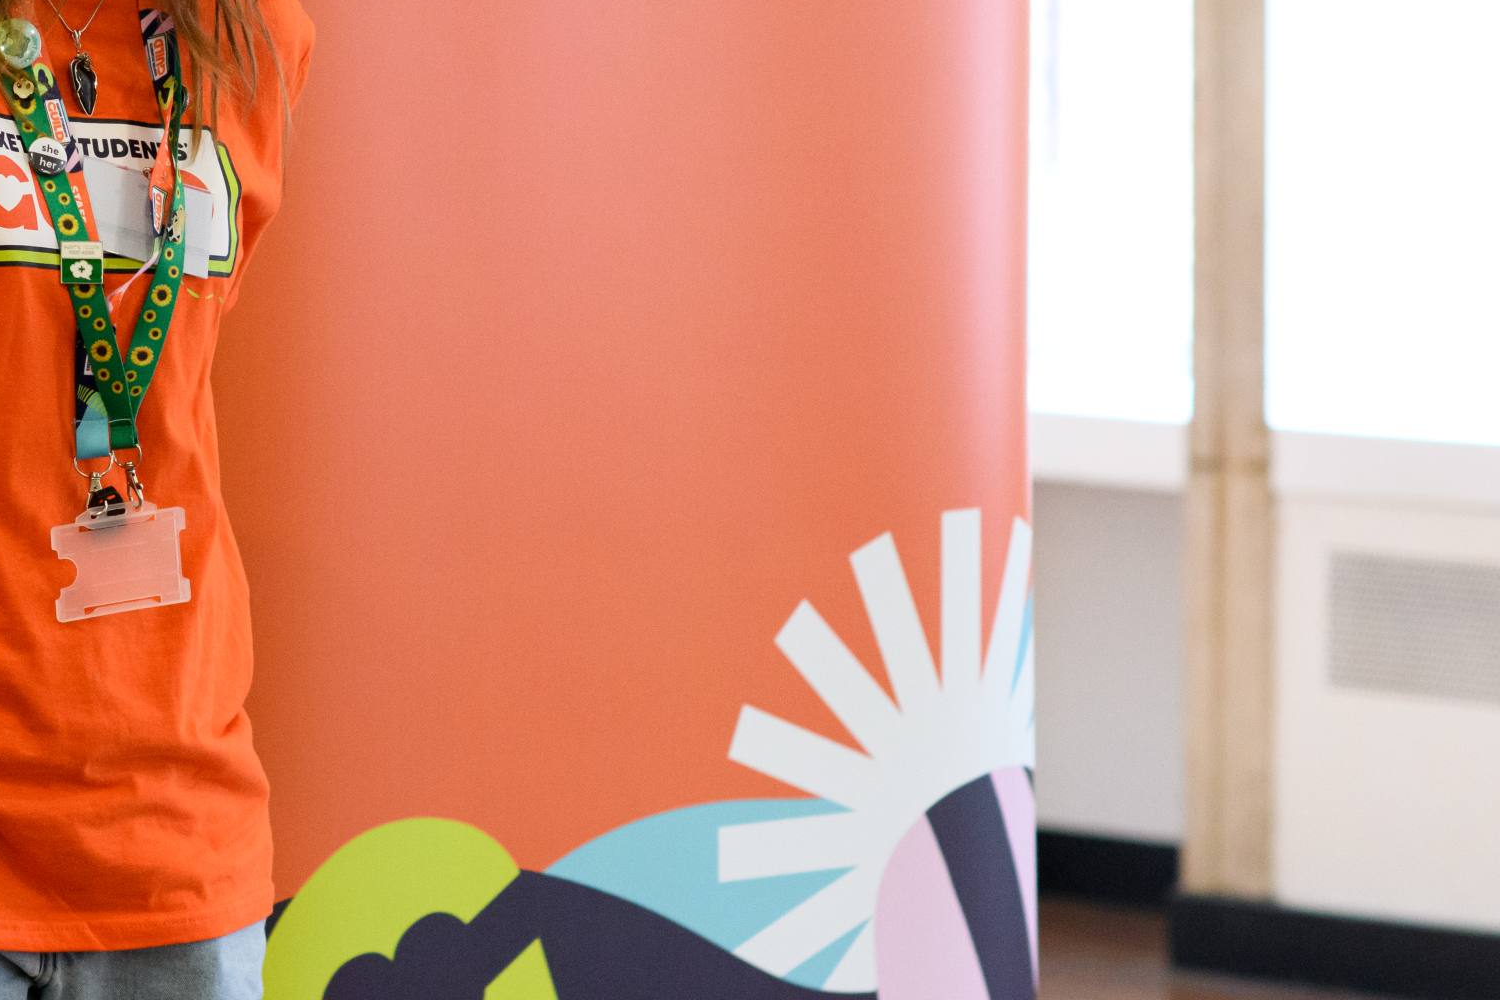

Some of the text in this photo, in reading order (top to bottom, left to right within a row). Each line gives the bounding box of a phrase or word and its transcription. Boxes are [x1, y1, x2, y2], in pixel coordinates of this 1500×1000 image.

[153, 38, 166, 77] GUILD
[47, 101, 65, 141] GUILD
[41, 144, 60, 156] she
[39, 157, 58, 170] her
